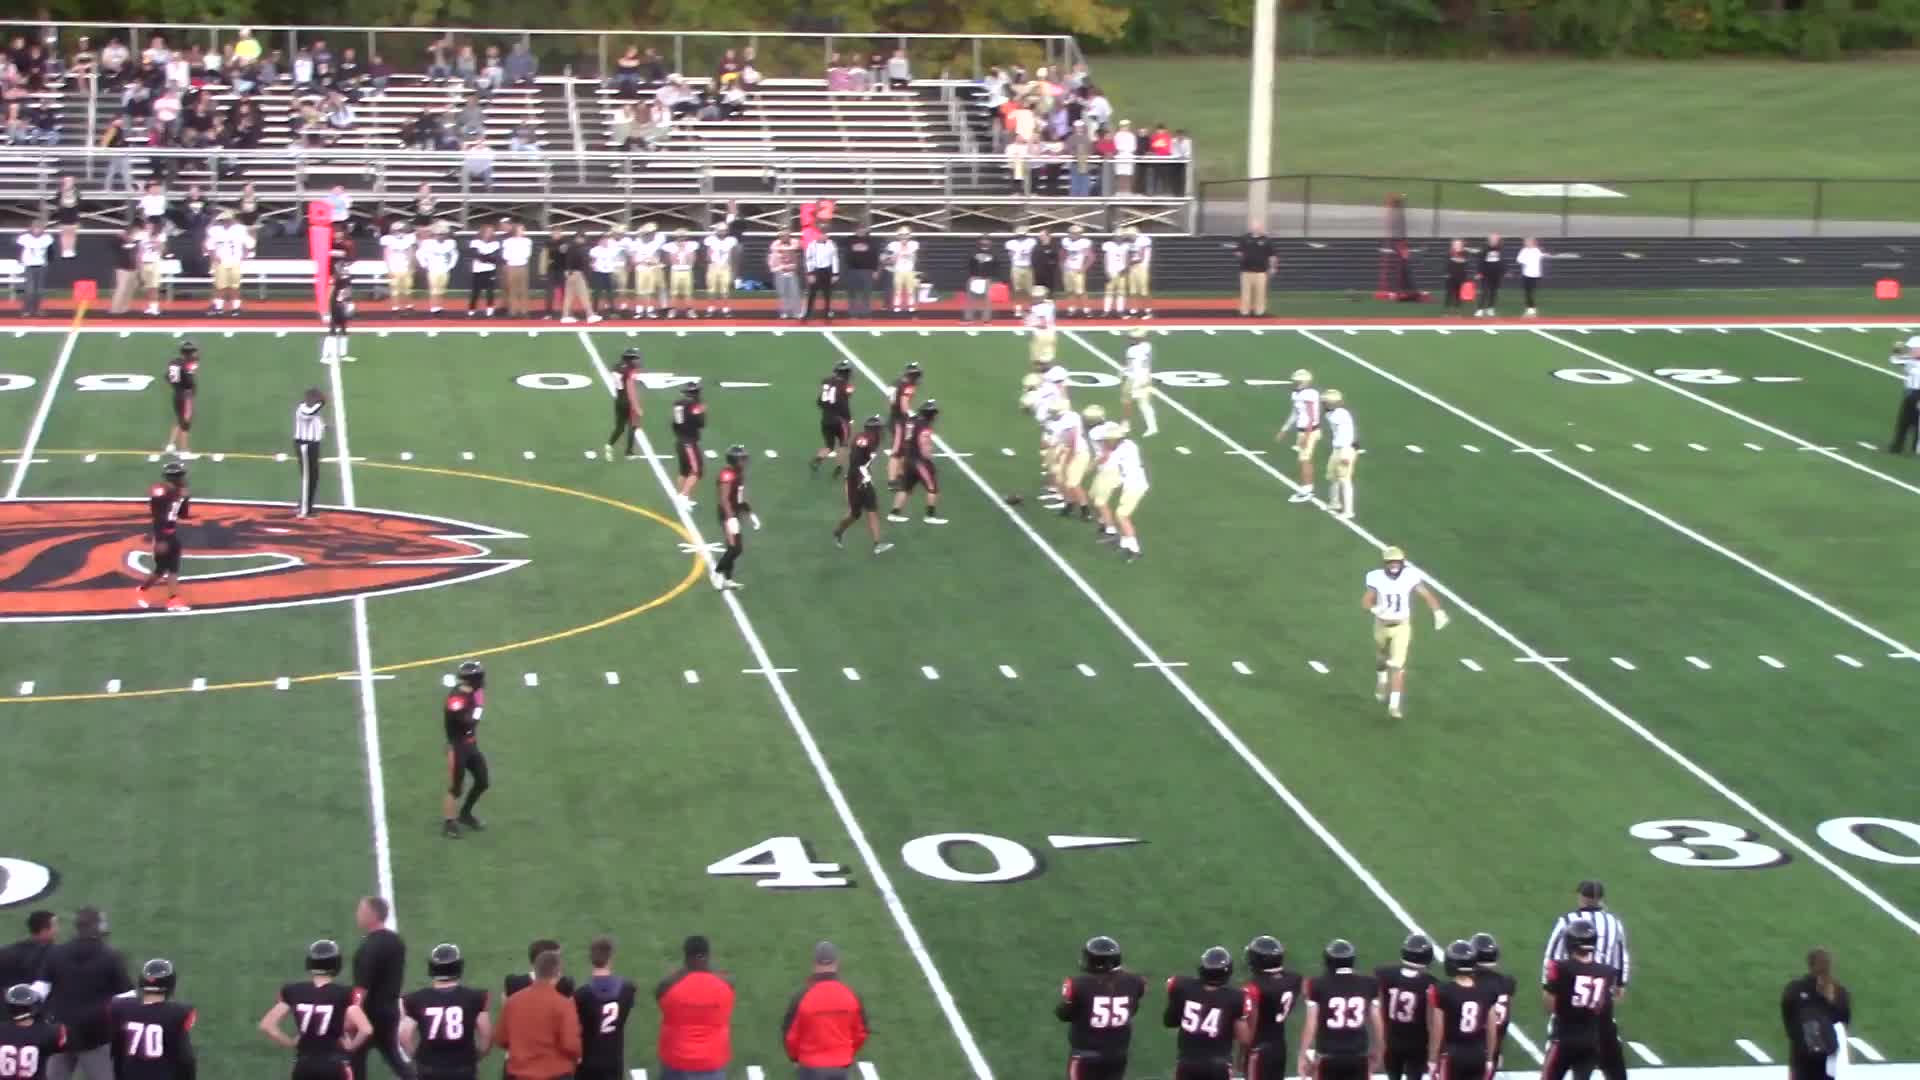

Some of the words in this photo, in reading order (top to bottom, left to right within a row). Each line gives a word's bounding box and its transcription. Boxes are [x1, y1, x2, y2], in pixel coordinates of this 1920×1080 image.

[1388, 987, 1416, 1022] 13
[1571, 974, 1604, 1008] 51
[296, 1003, 334, 1036] 77
[425, 1006, 464, 1040] 78
[600, 1001, 619, 1033] 2
[1090, 996, 1130, 1028] 55
[1181, 1000, 1222, 1038] 54
[1327, 996, 1366, 1029] 33
[1459, 1001, 1479, 1033] 8
[127, 1021, 163, 1057] 70
[0, 1045, 39, 1078] 69
